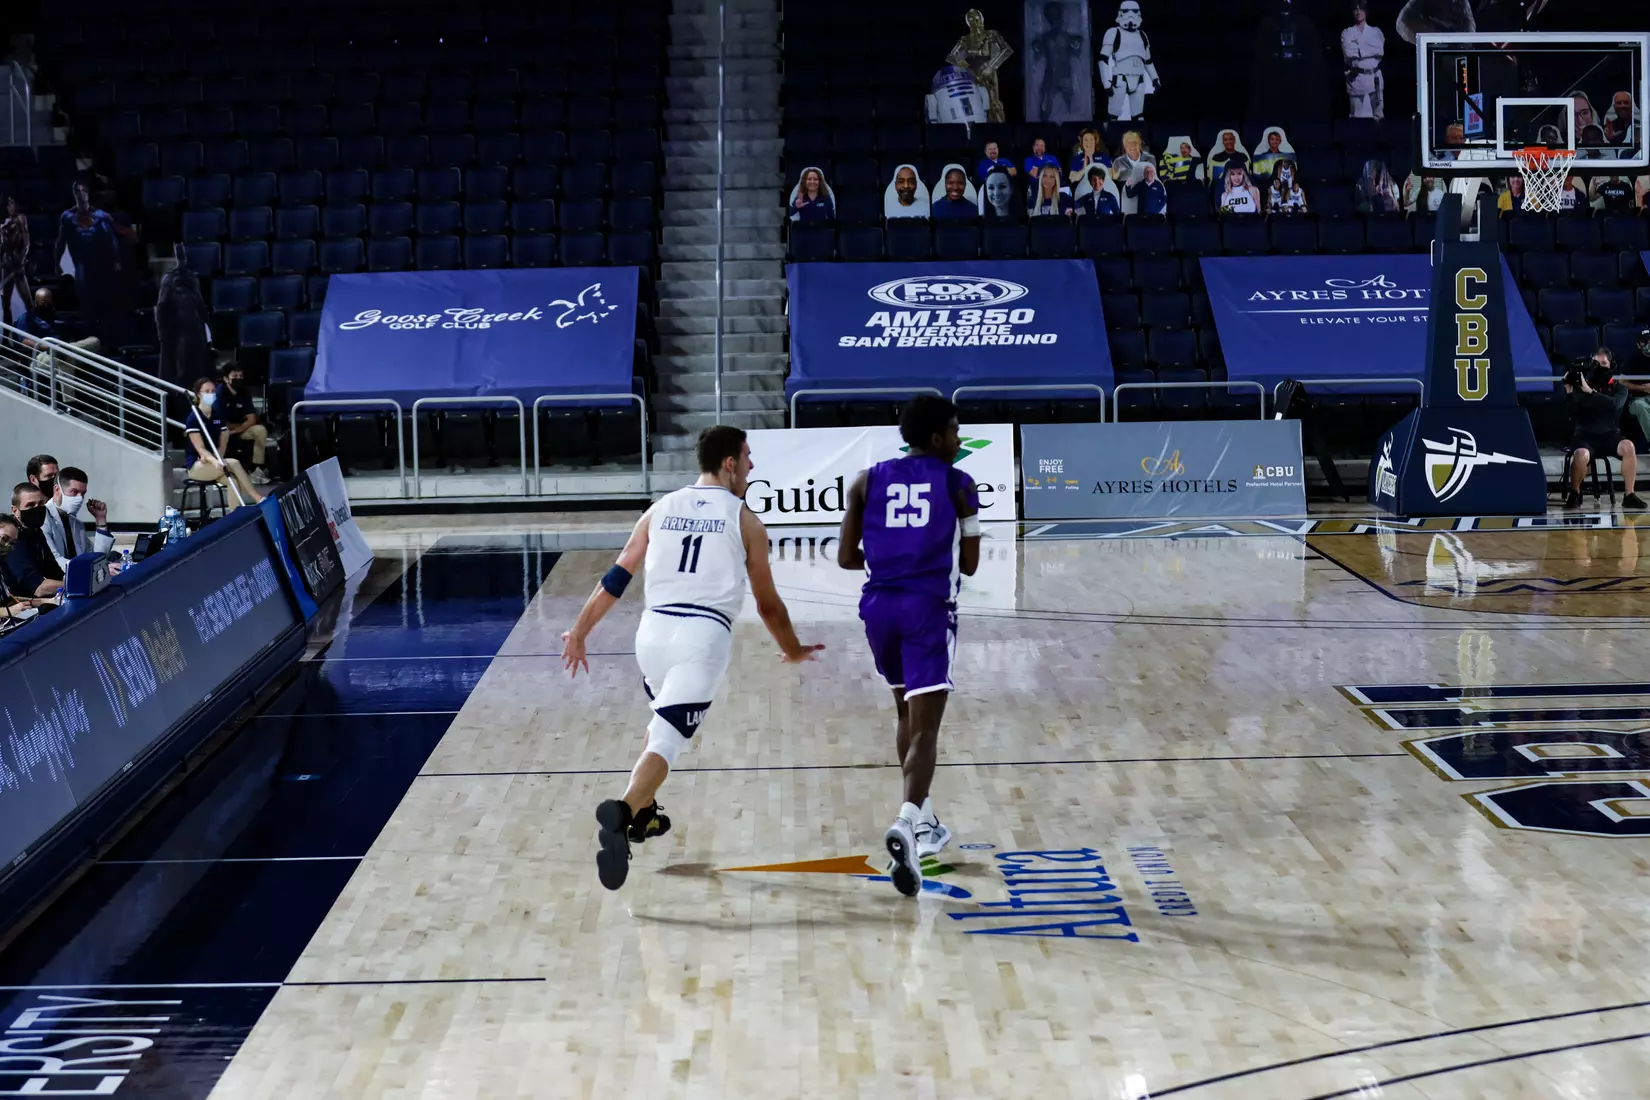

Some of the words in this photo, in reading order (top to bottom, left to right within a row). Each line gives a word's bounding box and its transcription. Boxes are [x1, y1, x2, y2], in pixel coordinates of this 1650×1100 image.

[1229, 197, 1248, 206] CBU
[904, 283, 993, 296] FOX
[1248, 289, 1348, 301] AYRES
[1362, 288, 1431, 300] HOT
[904, 294, 994, 302] SPORTS
[339, 309, 442, 330] Goose
[444, 307, 543, 323] Creek
[1300, 316, 1361, 325] ELEVATE
[1367, 315, 1407, 324] YOUR
[389, 322, 436, 330] GOLF
[442, 322, 491, 330] CLUB
[883, 324, 1012, 338] RIVERSIDE
[838, 336, 890, 347] SAN
[896, 333, 1058, 347] BERNARDINO
[1454, 267, 1490, 401] CBU
[1039, 465, 1064, 473] FREE
[1266, 466, 1294, 477] CBU
[1092, 480, 1154, 494] AYRES
[1162, 479, 1238, 493] HOTELS
[885, 483, 932, 528] 25
[660, 516, 726, 533] ARMSTRONG
[678, 534, 704, 573] 11
[112, 635, 157, 708] SEND
[1126, 847, 1175, 875] UNION
[947, 848, 1139, 942] Altura
[1144, 880, 1198, 916] CREDIT
